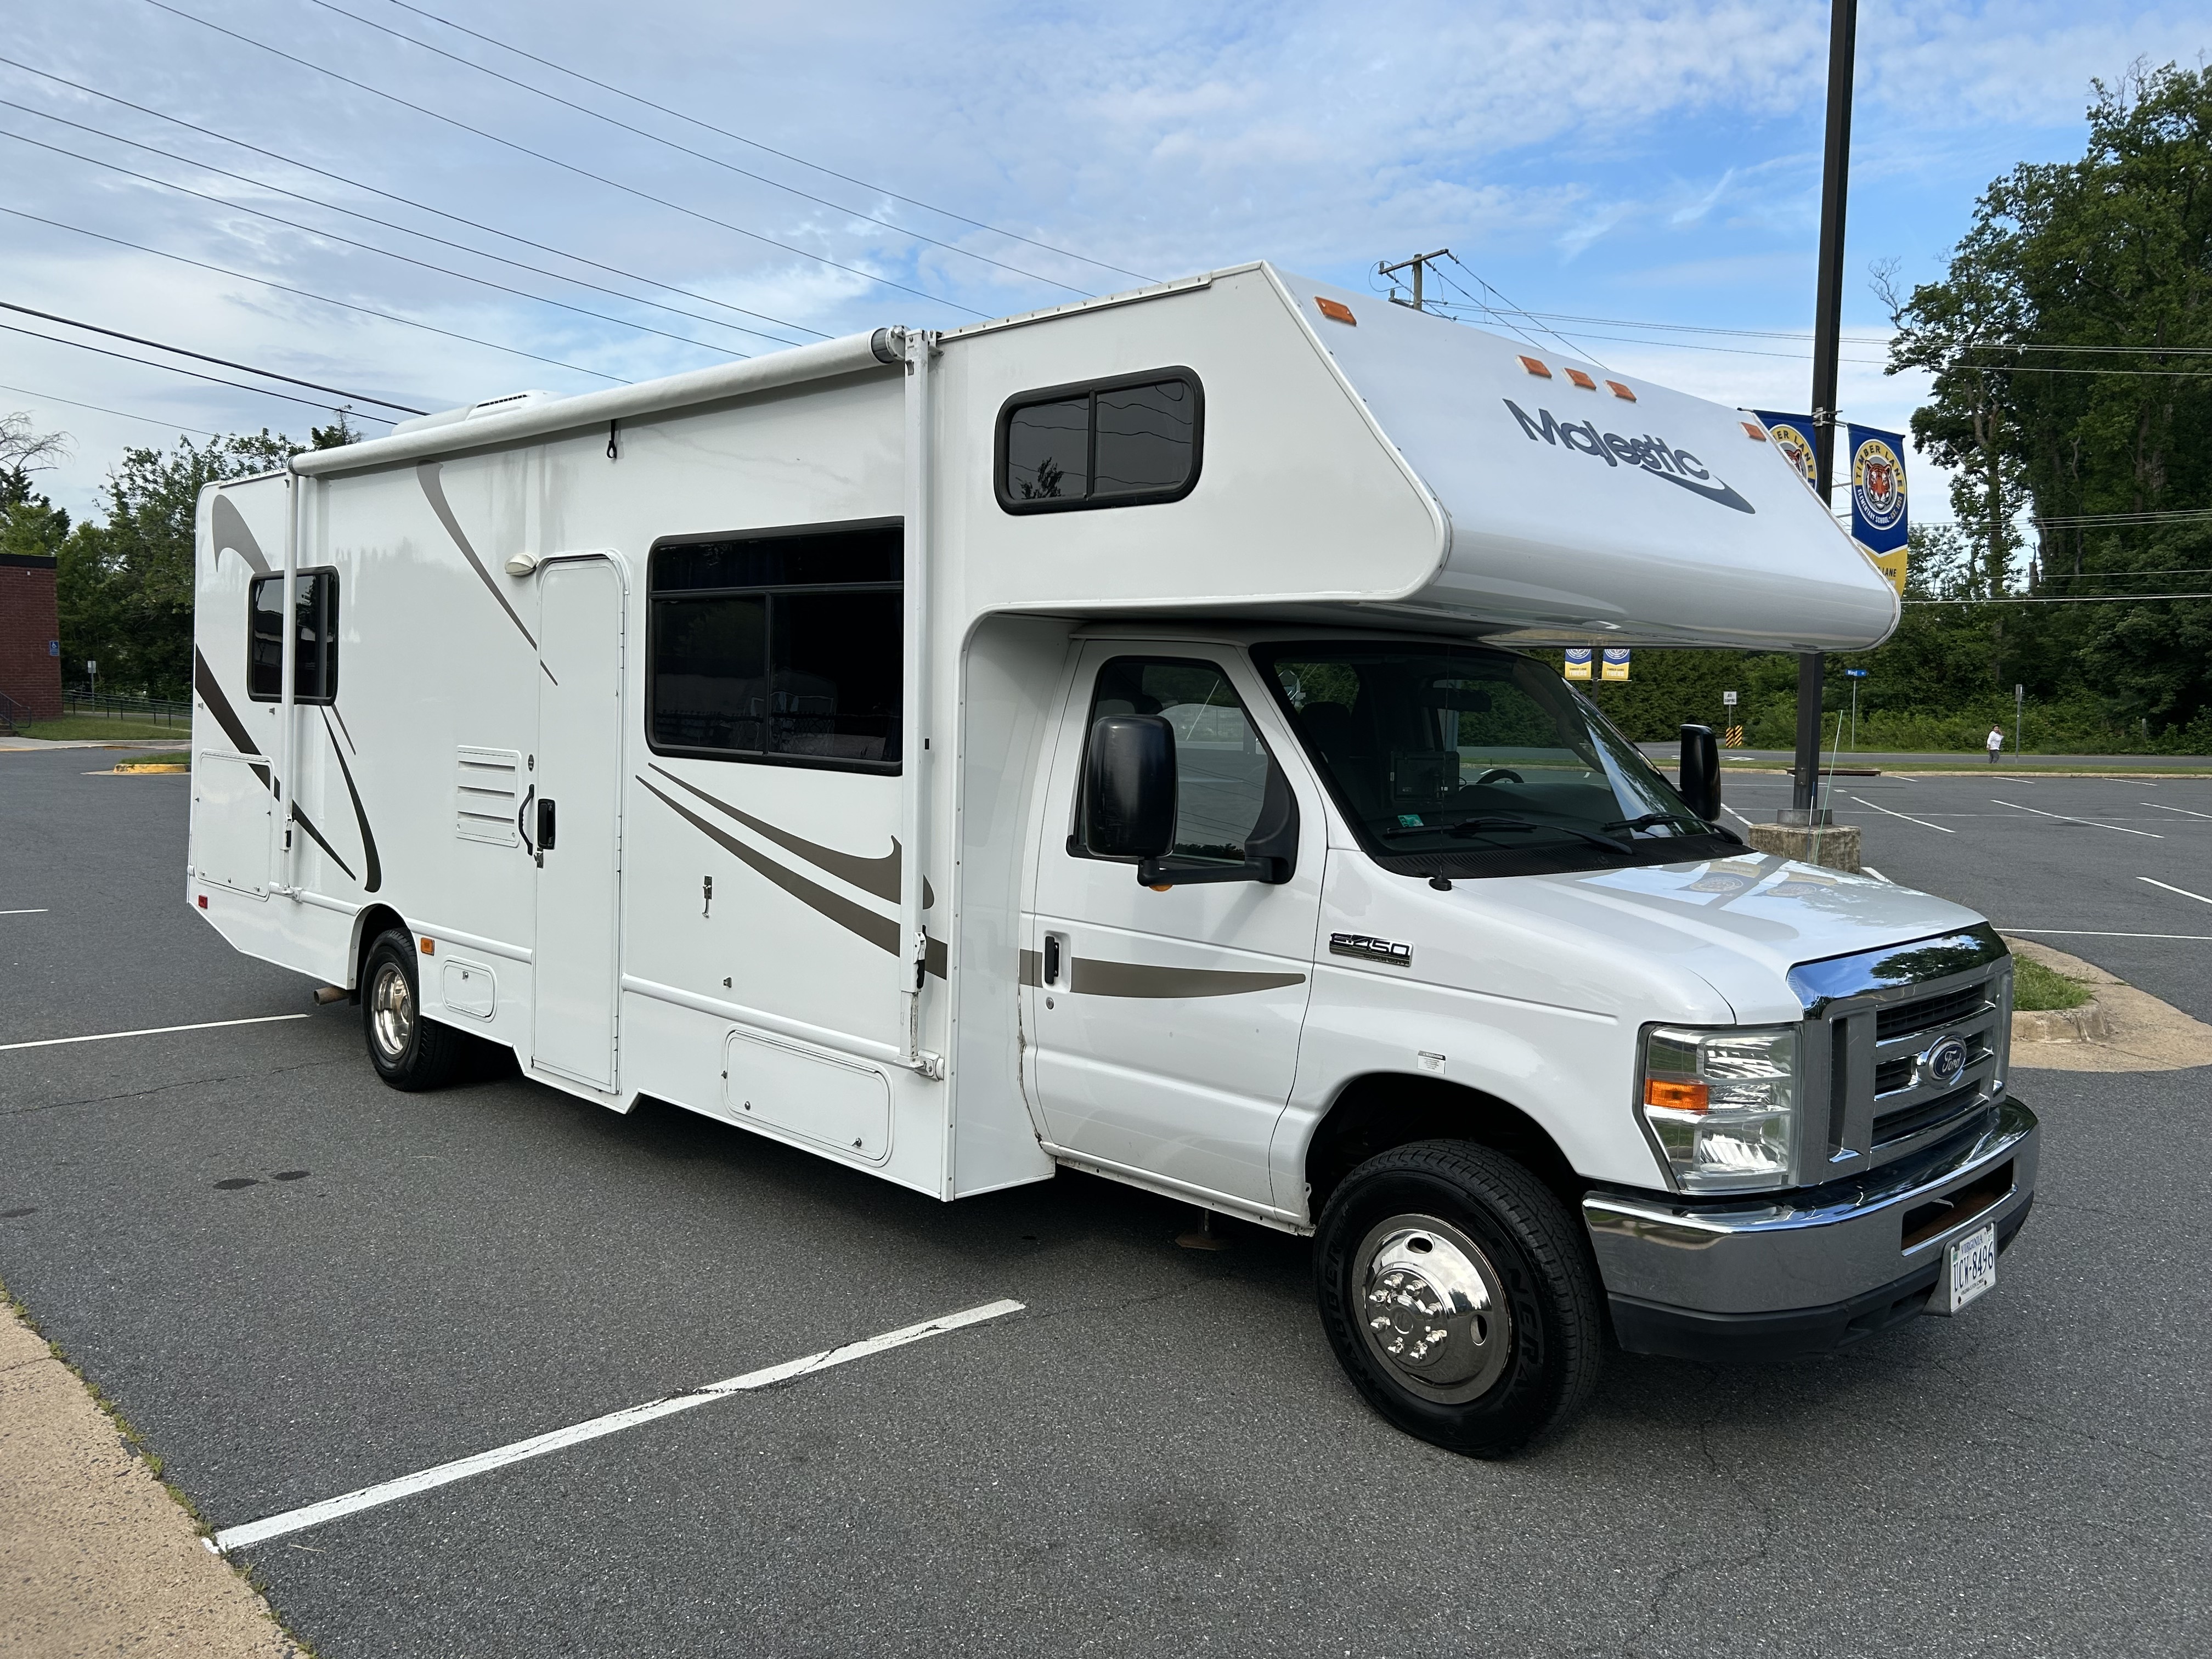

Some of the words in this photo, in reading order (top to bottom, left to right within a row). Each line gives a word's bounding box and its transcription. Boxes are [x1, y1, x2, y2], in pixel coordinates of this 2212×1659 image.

[1502, 398, 1709, 480] Majestic
[1793, 436, 1814, 472] LANE
[1856, 445, 1881, 478] TIMBER
[1885, 451, 1903, 487] LANE
[1858, 489, 1875, 521] ELEMENTARY
[1882, 567, 1897, 577] LANE
[1942, 1049, 1962, 1073] Ford
[1961, 1234, 1983, 1255] VIRGINIA
[1954, 1241, 1993, 1292] UCW-8496
